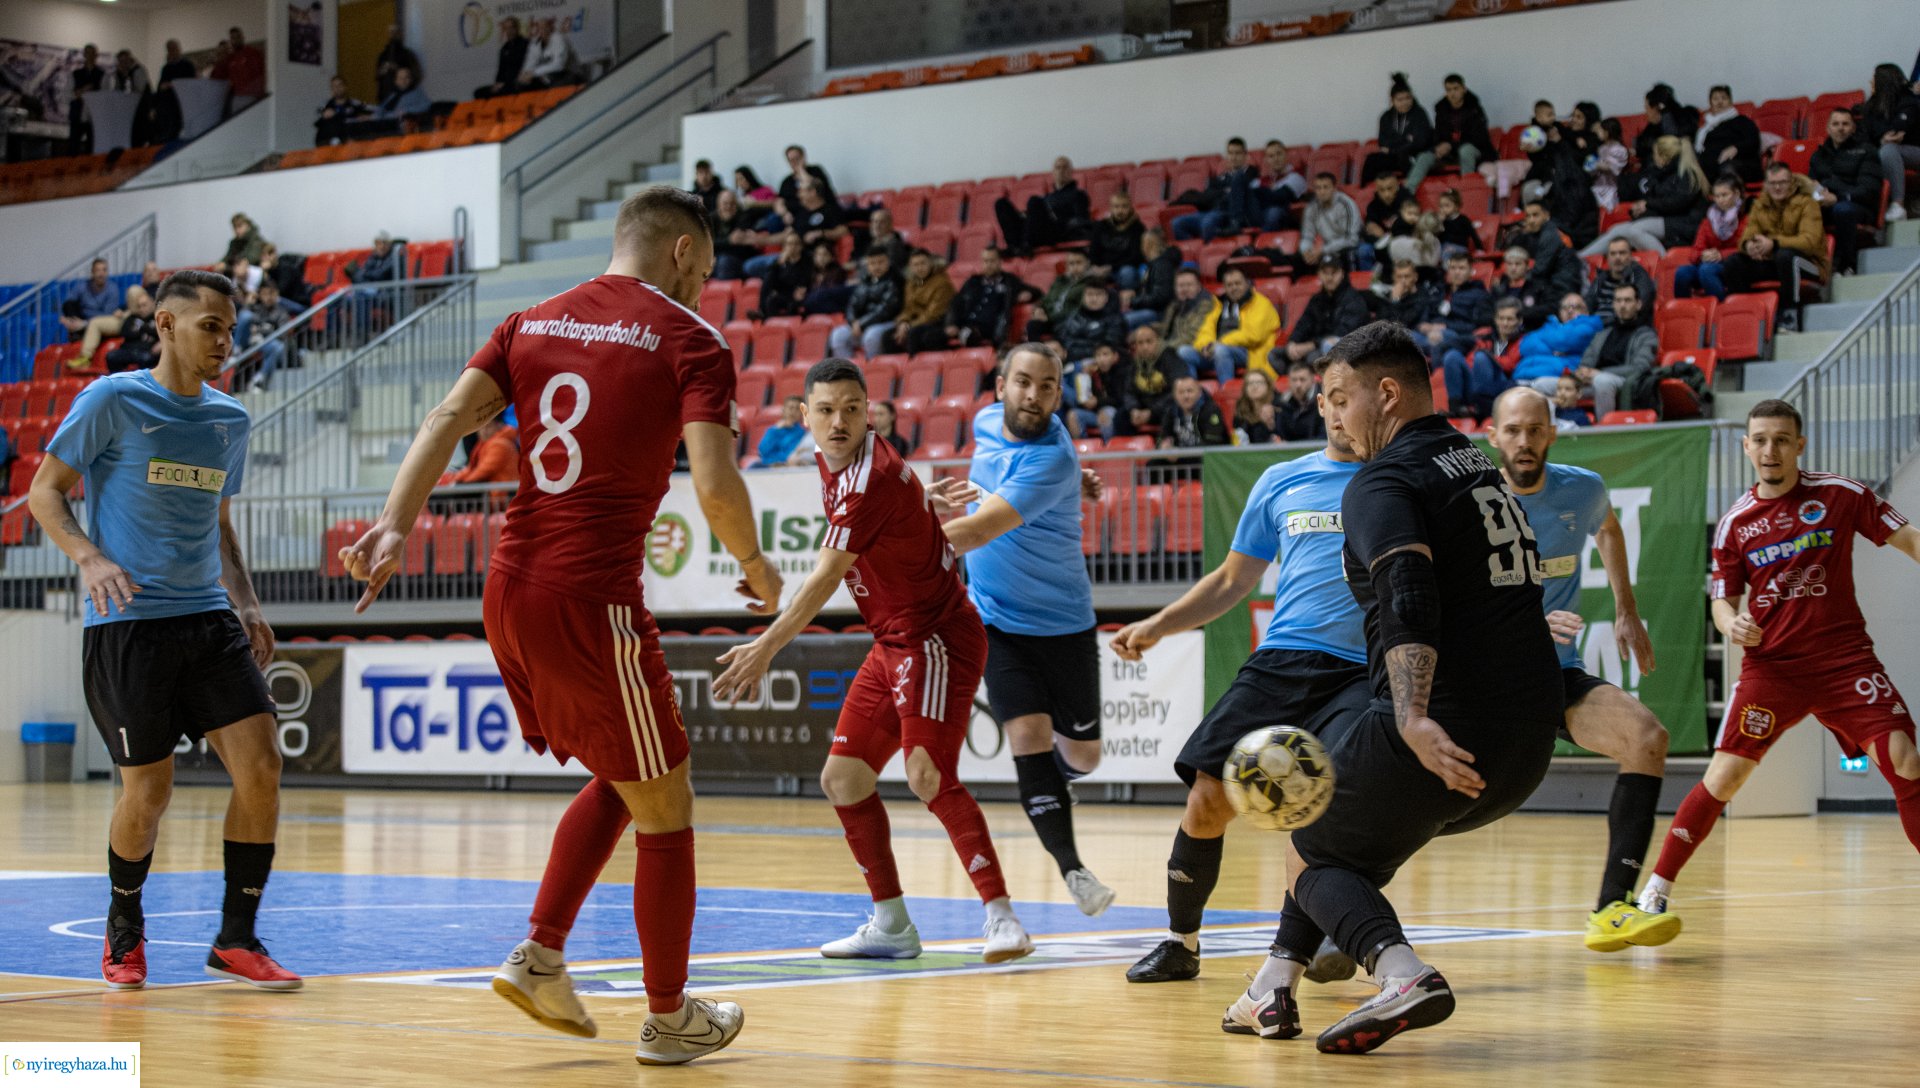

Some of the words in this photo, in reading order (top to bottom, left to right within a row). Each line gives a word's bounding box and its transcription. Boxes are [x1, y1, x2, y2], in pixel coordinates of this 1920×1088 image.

[520, 314, 661, 351] www.raktarsportbolt.hu
[529, 372, 591, 494] 8
[1737, 517, 1770, 543] 383
[1757, 584, 1827, 608] STUDIO
[1113, 659, 1147, 680] the
[1855, 672, 1892, 704] 99
[361, 666, 510, 754] Ta-Te
[119, 727, 130, 758] 1
[1103, 739, 1163, 757] water
